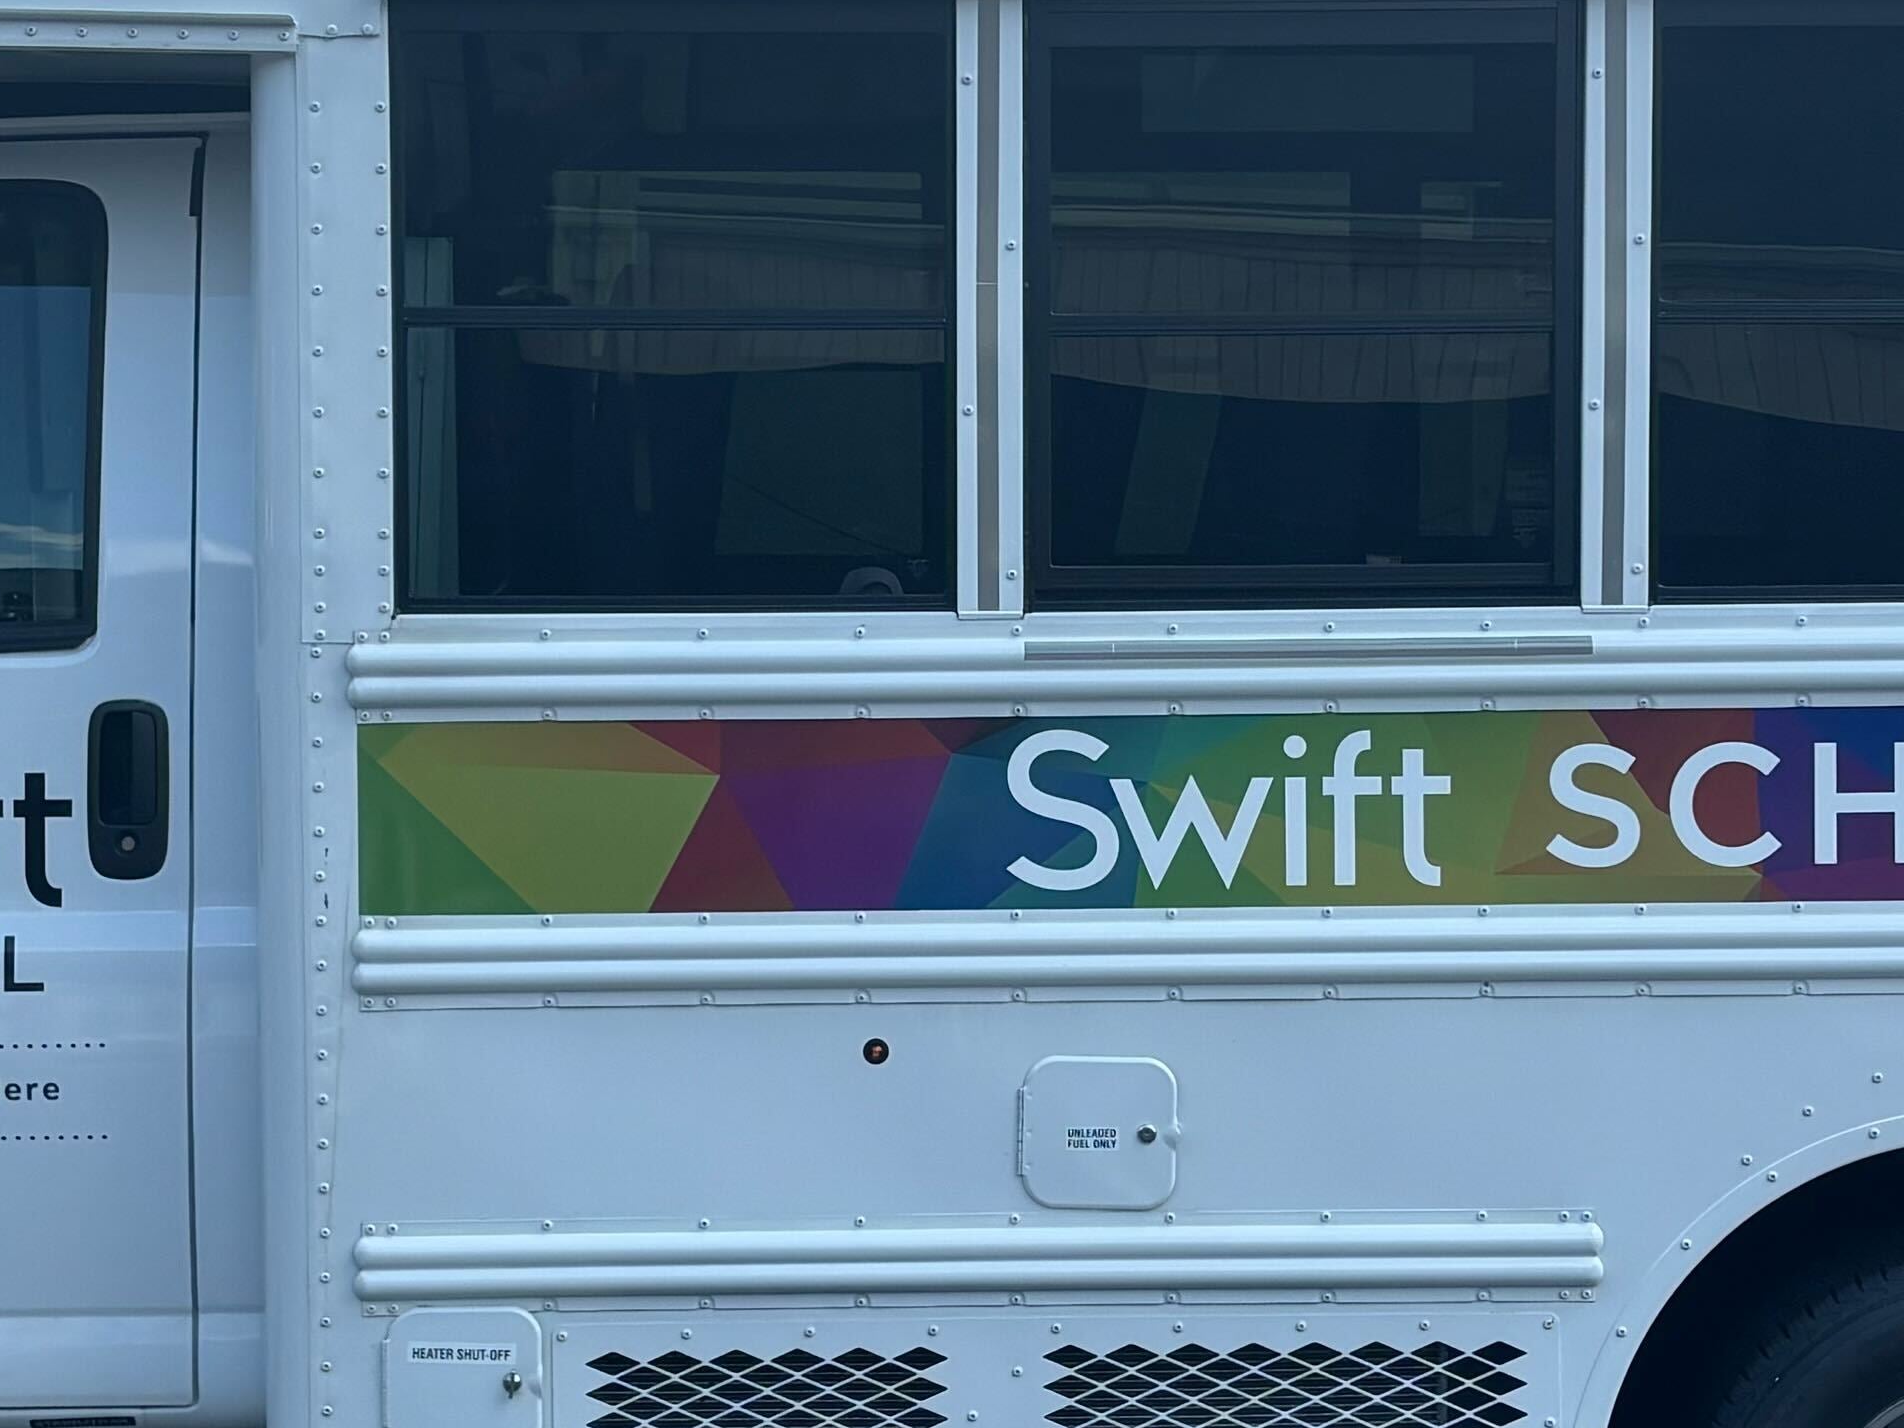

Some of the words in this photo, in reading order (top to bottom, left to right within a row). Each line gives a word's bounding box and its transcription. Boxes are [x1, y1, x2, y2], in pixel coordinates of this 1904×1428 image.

[1007, 729, 1453, 892] Swift
[1067, 1128, 1117, 1138] UNLEADED
[1067, 1139, 1090, 1149] FUEL
[1093, 1139, 1117, 1149] ONLY
[411, 1347, 454, 1360] HEATER
[456, 1348, 512, 1361] SHUT-OFF
